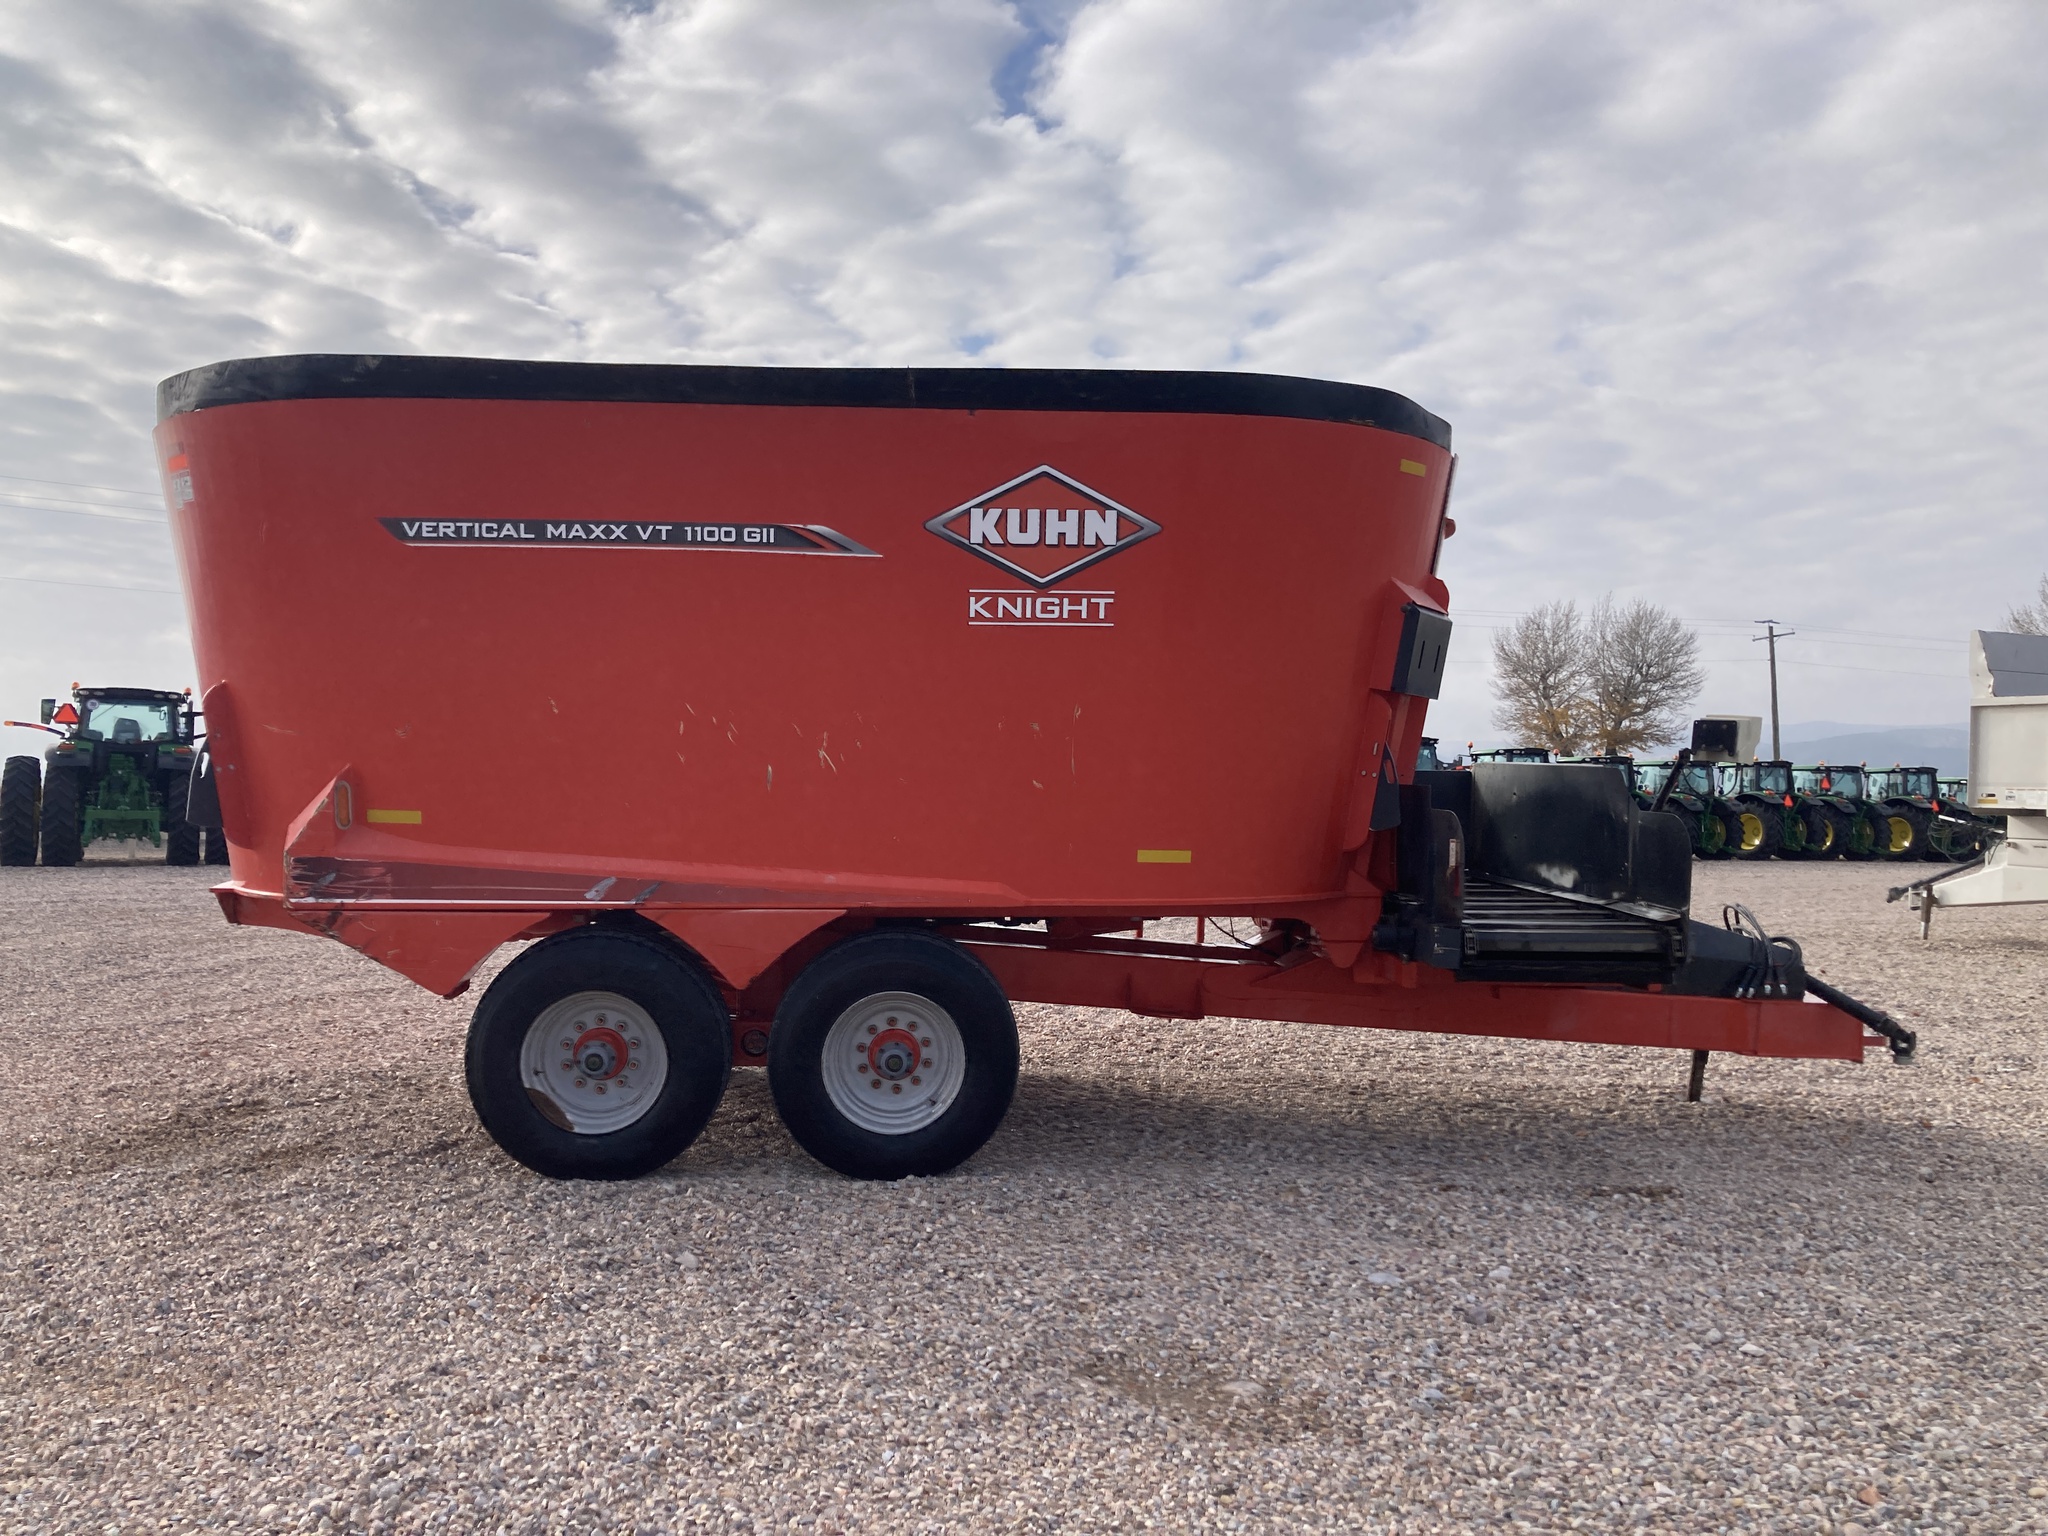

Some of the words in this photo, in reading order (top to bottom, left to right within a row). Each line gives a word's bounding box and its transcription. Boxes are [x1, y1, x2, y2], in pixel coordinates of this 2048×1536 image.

[402, 521, 535, 539] VERTICAL
[546, 523, 628, 540] MAXX
[635, 525, 673, 541] VT
[684, 526, 736, 542] 1100
[743, 527, 775, 543] GII
[969, 507, 1118, 547] KUHN
[969, 596, 1114, 619] KNIGHT
